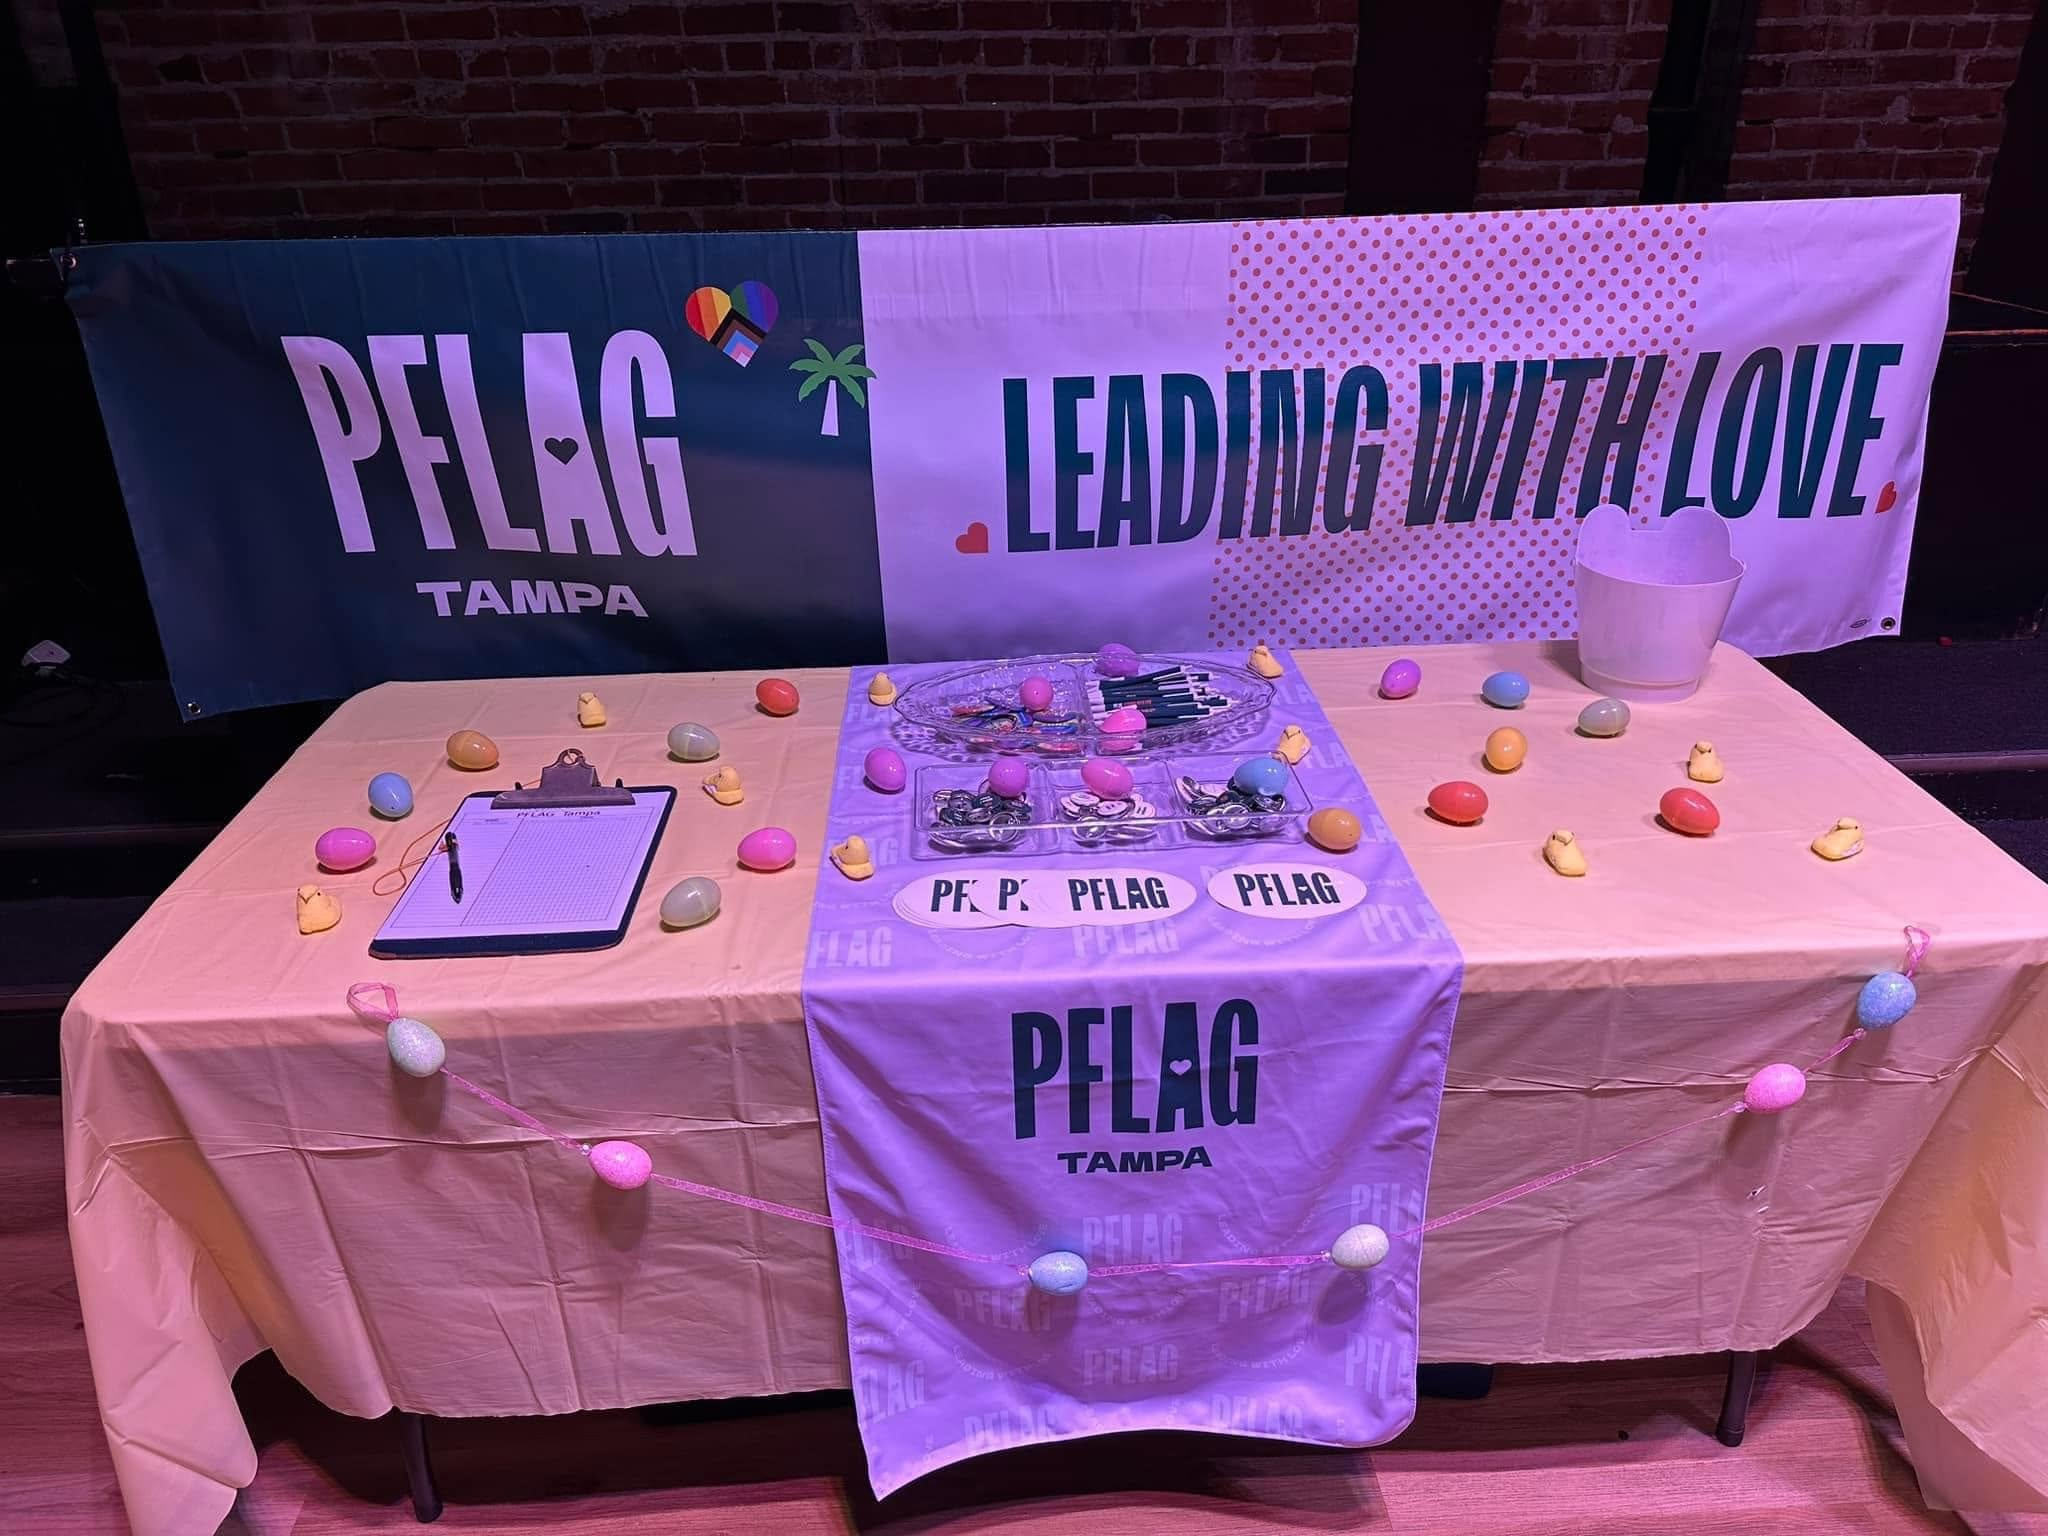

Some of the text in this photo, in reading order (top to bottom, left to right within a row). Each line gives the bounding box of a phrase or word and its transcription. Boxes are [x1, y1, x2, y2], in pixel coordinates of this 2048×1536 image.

[281, 330, 698, 557] PFLAG
[1003, 343, 1904, 553] LEADING WITH LOVE
[416, 580, 649, 618] TAMPA
[1068, 877, 1171, 911] PFLAG
[1233, 872, 1341, 907] PFLAG
[1011, 998, 1260, 1140] PFLAG
[1057, 1145, 1213, 1175] TAMPA
